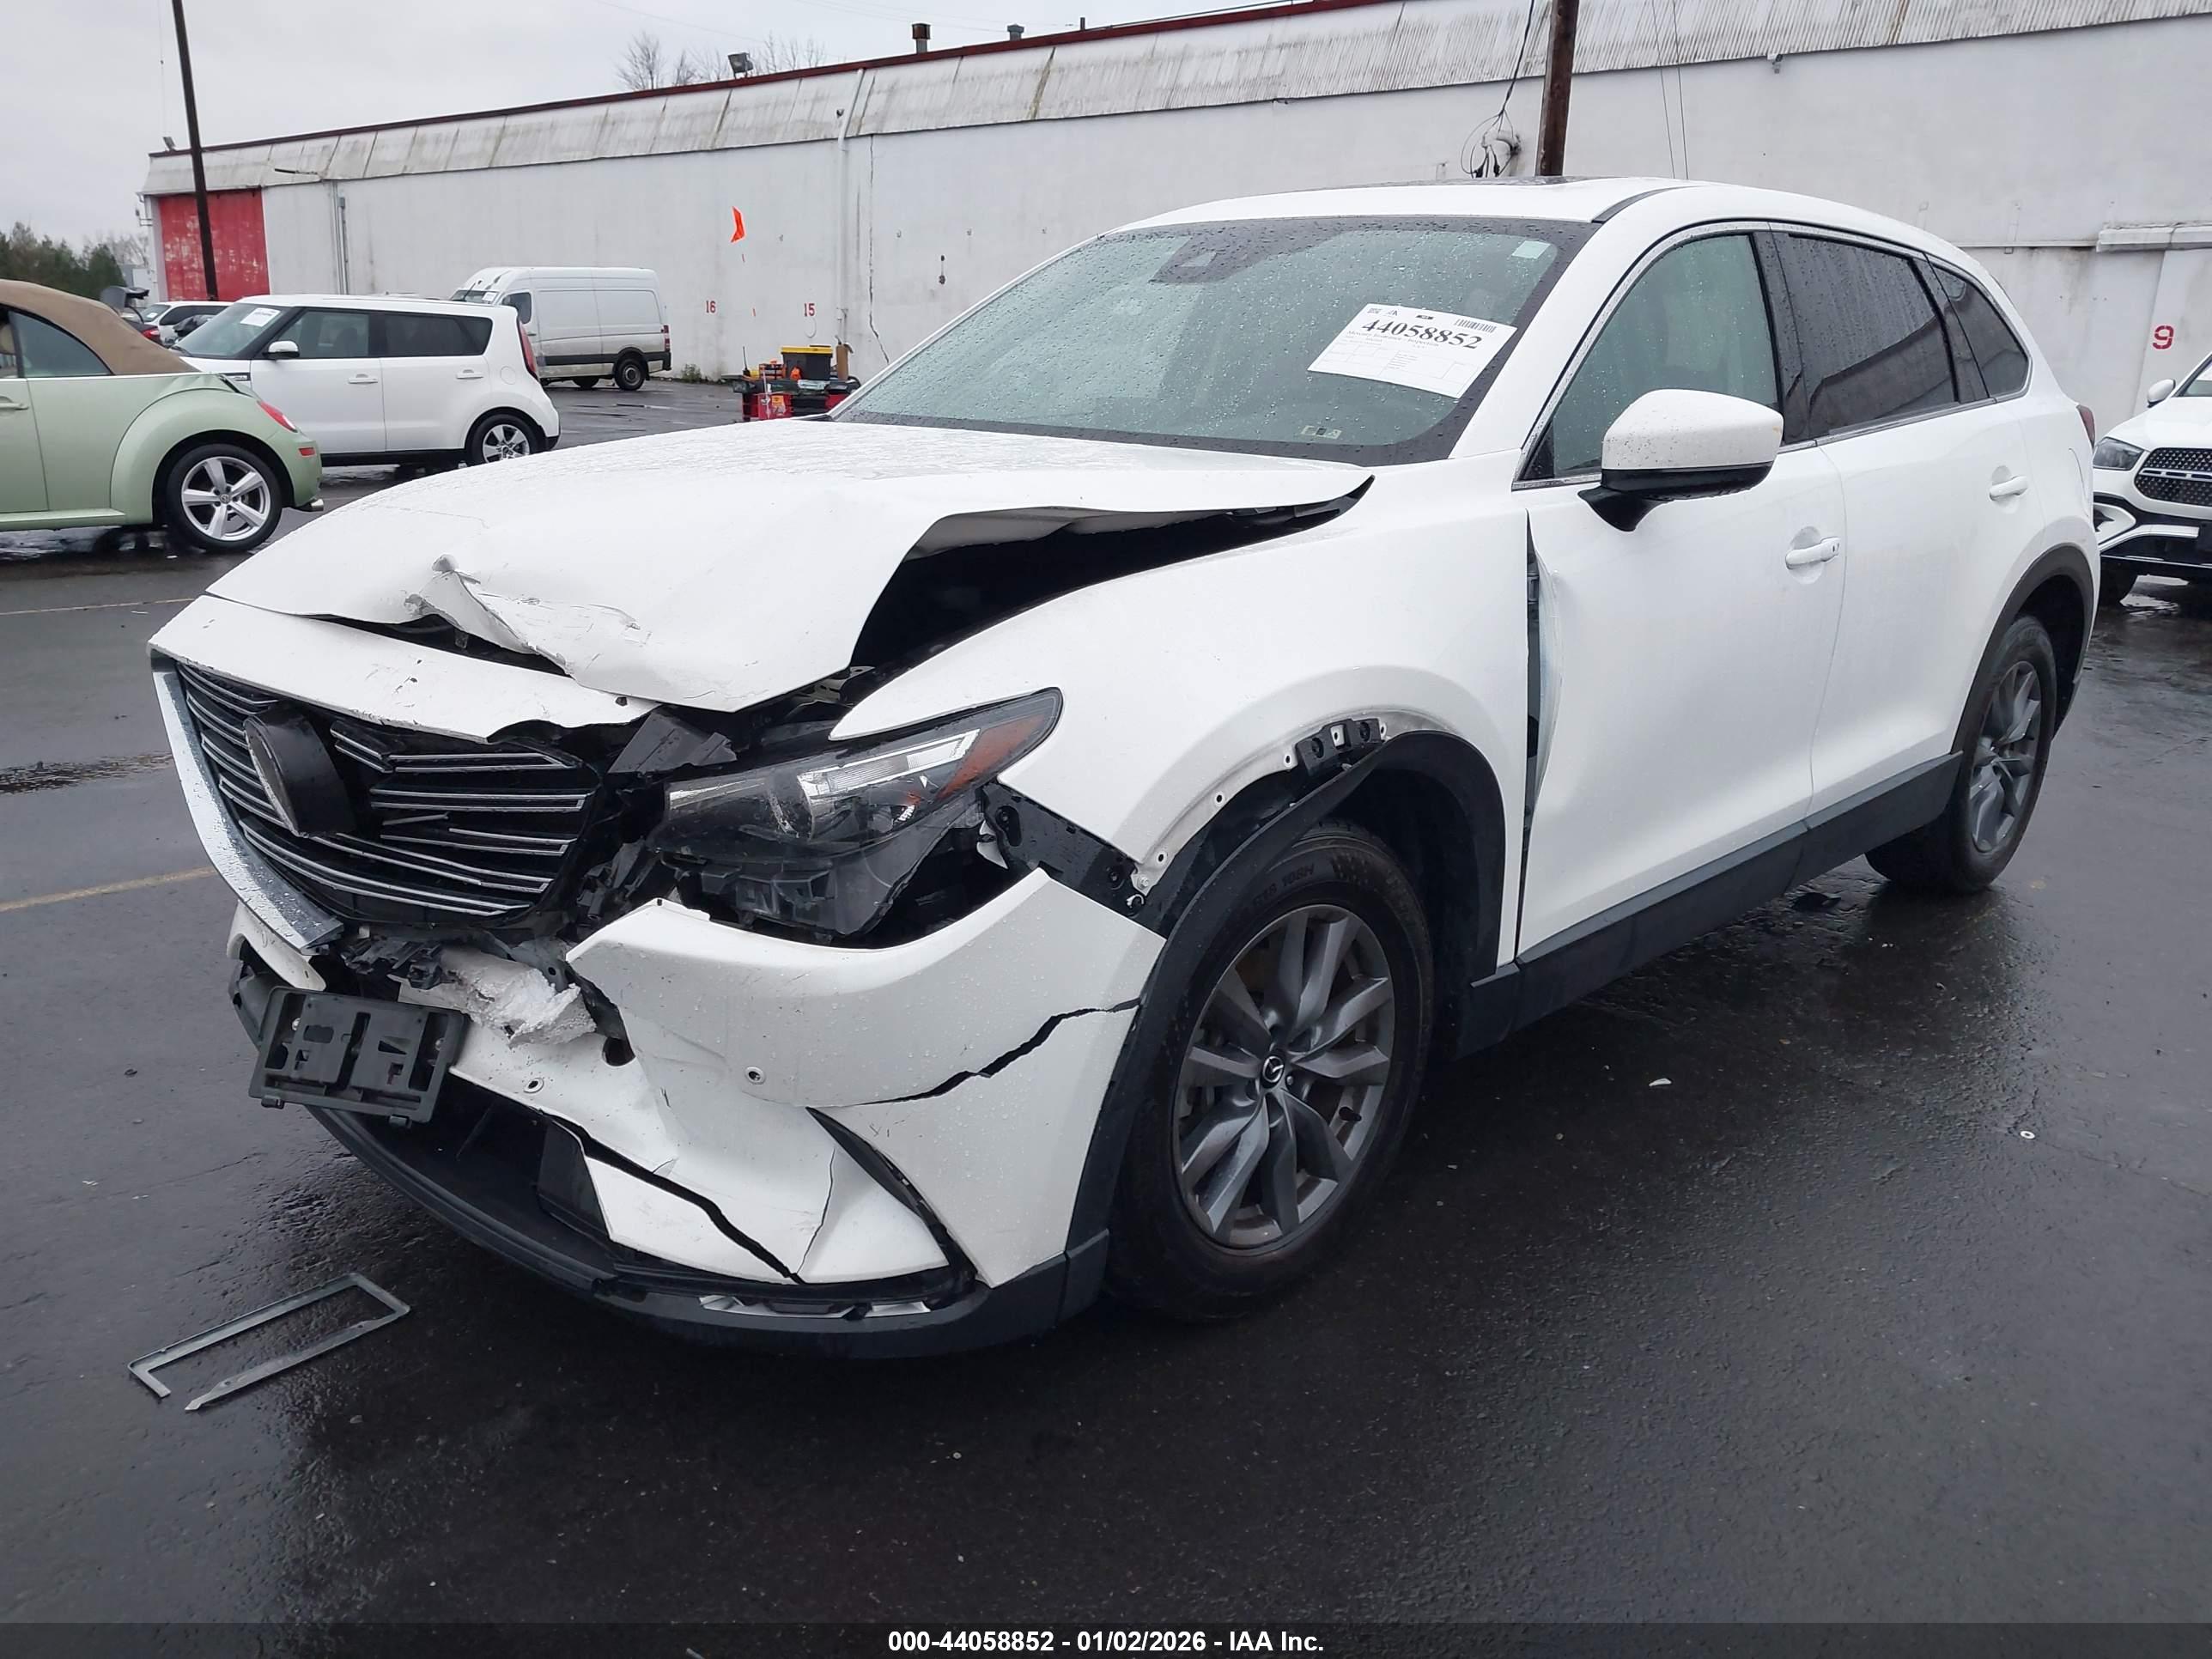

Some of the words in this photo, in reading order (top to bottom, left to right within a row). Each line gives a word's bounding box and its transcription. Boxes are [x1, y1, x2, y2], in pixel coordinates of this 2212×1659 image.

[706, 300, 716, 313] 16
[804, 303, 815, 317] 15
[1362, 319, 1483, 349] 44058852
[2152, 325, 2174, 349] 9
